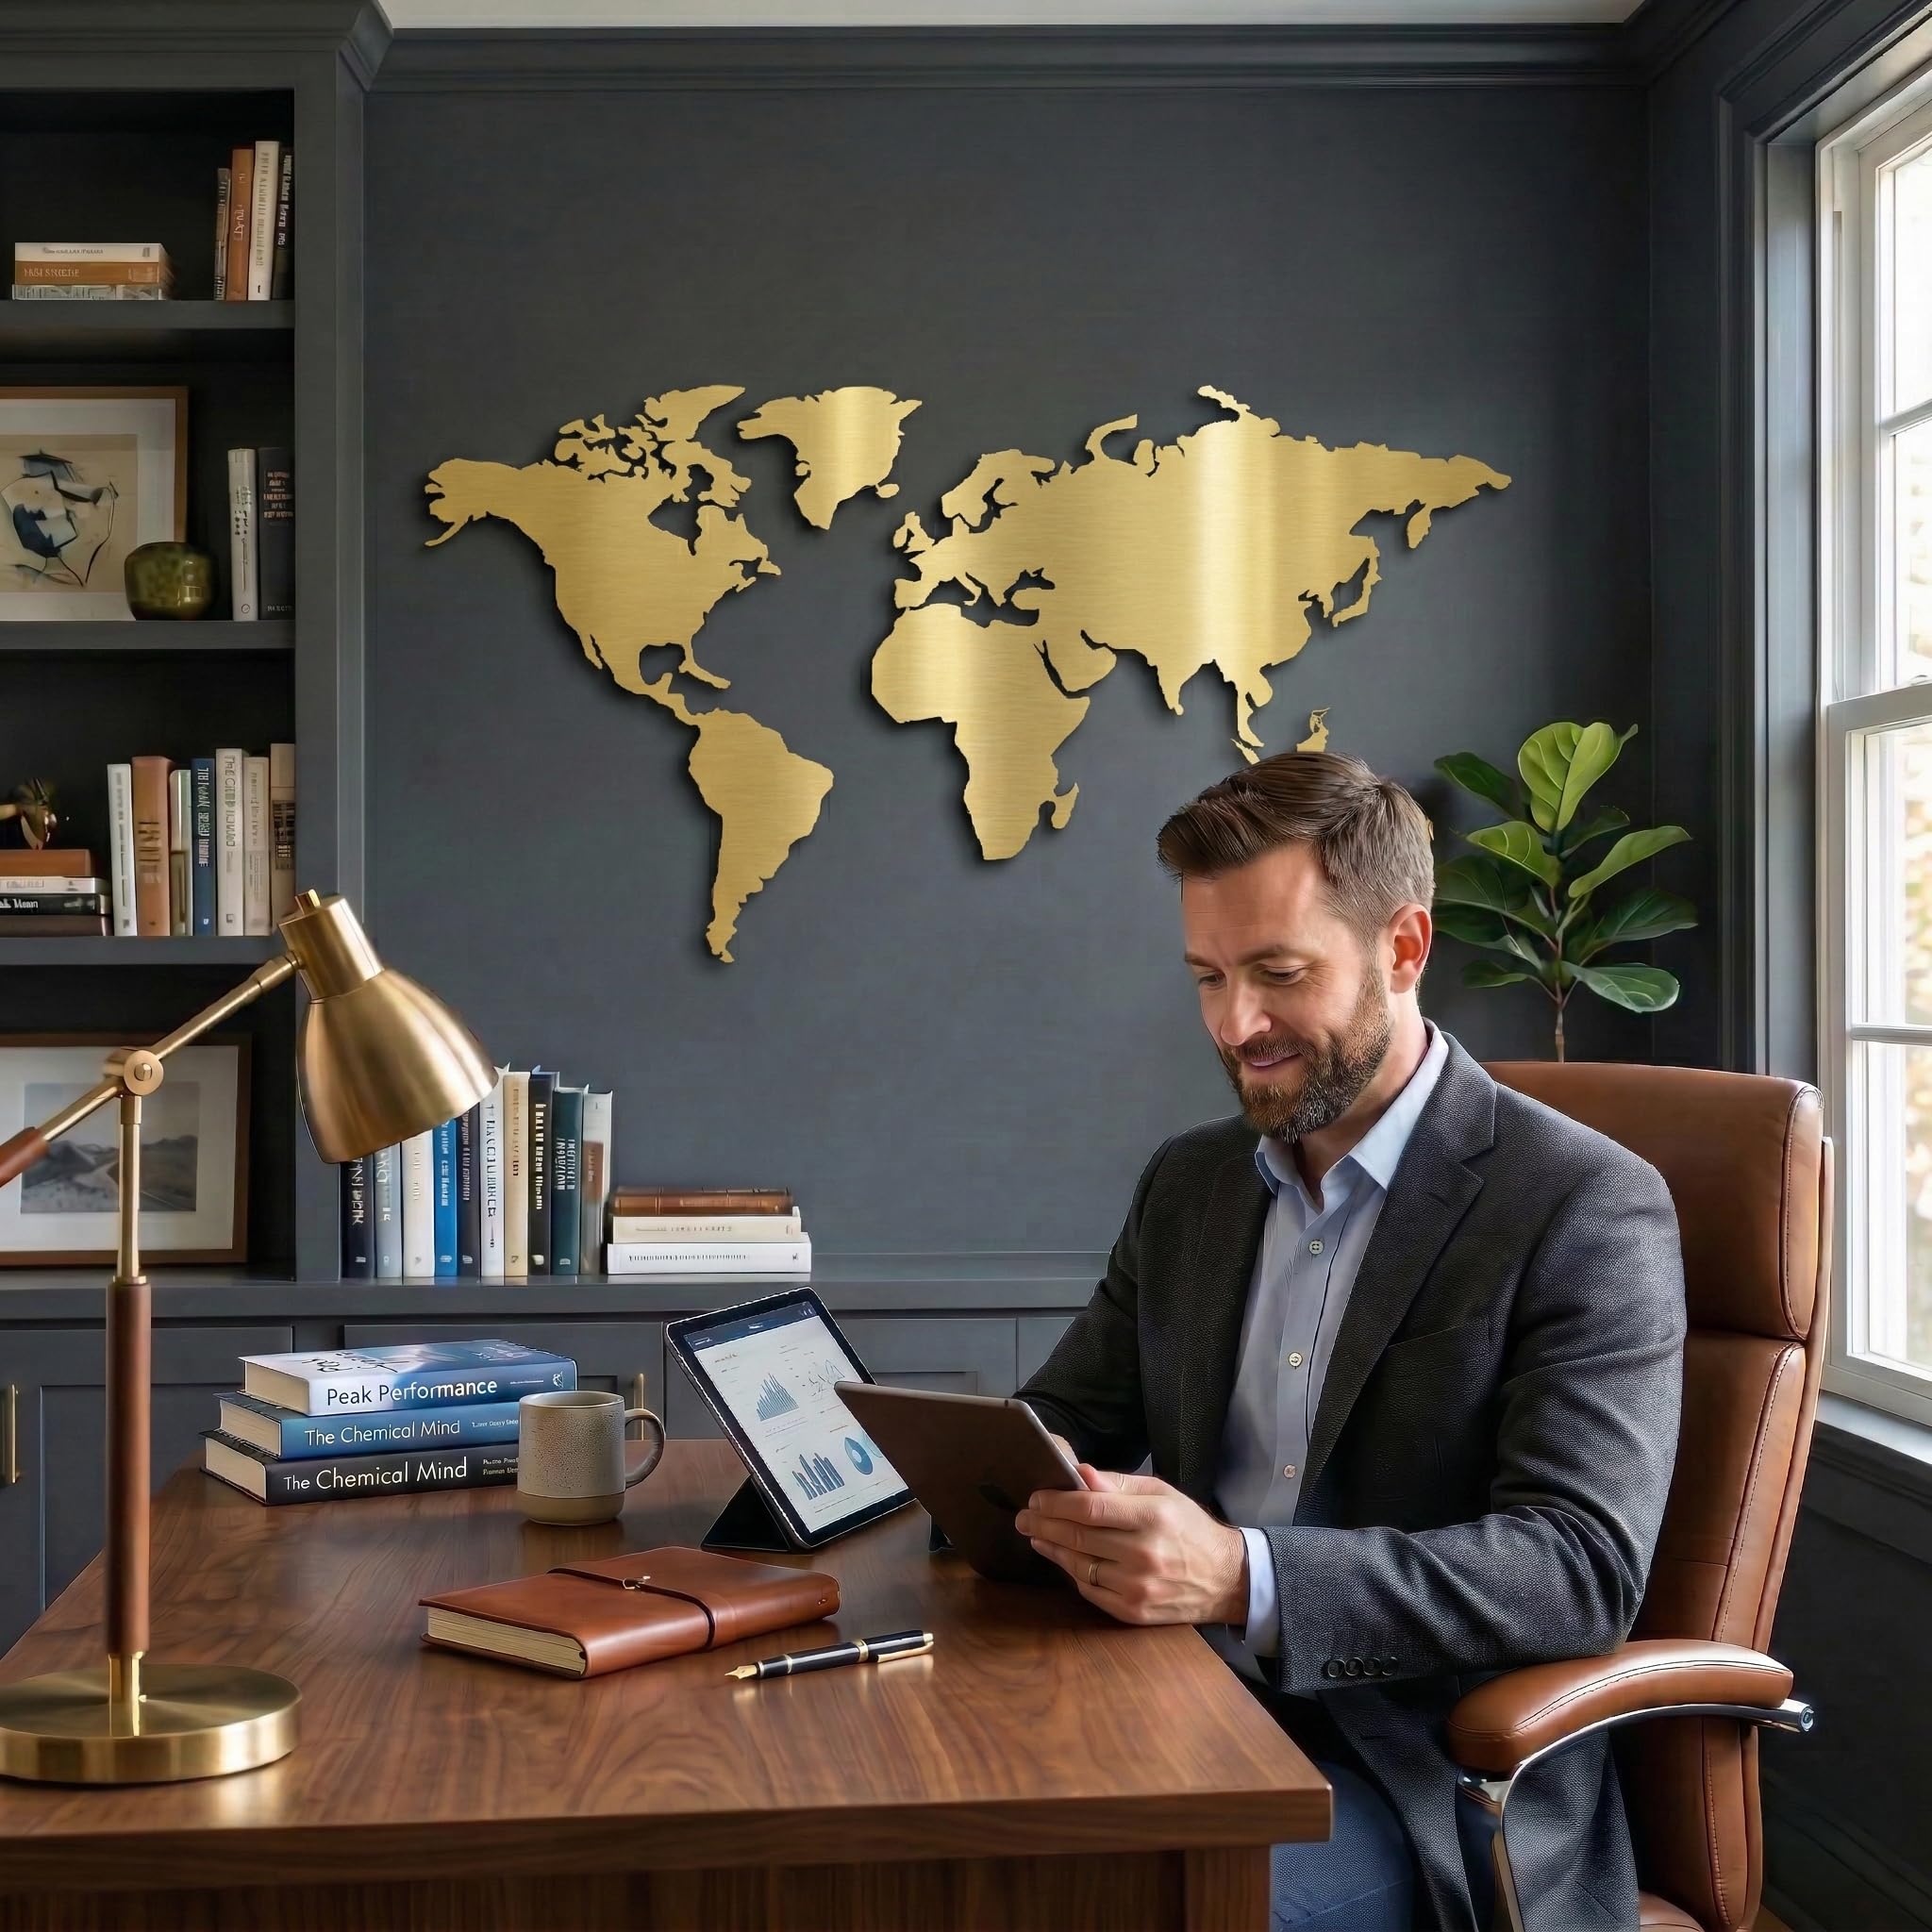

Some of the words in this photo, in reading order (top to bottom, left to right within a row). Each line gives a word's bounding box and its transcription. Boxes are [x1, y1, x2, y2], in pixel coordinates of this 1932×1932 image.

[327, 1386, 372, 1406] Peak
[379, 1380, 498, 1402] Performance
[305, 1429, 335, 1446] The
[341, 1422, 415, 1442] Chemical
[421, 1420, 460, 1438] Mind
[283, 1475, 310, 1491] The
[316, 1461, 408, 1490] Chemical
[417, 1457, 467, 1482] Mind
